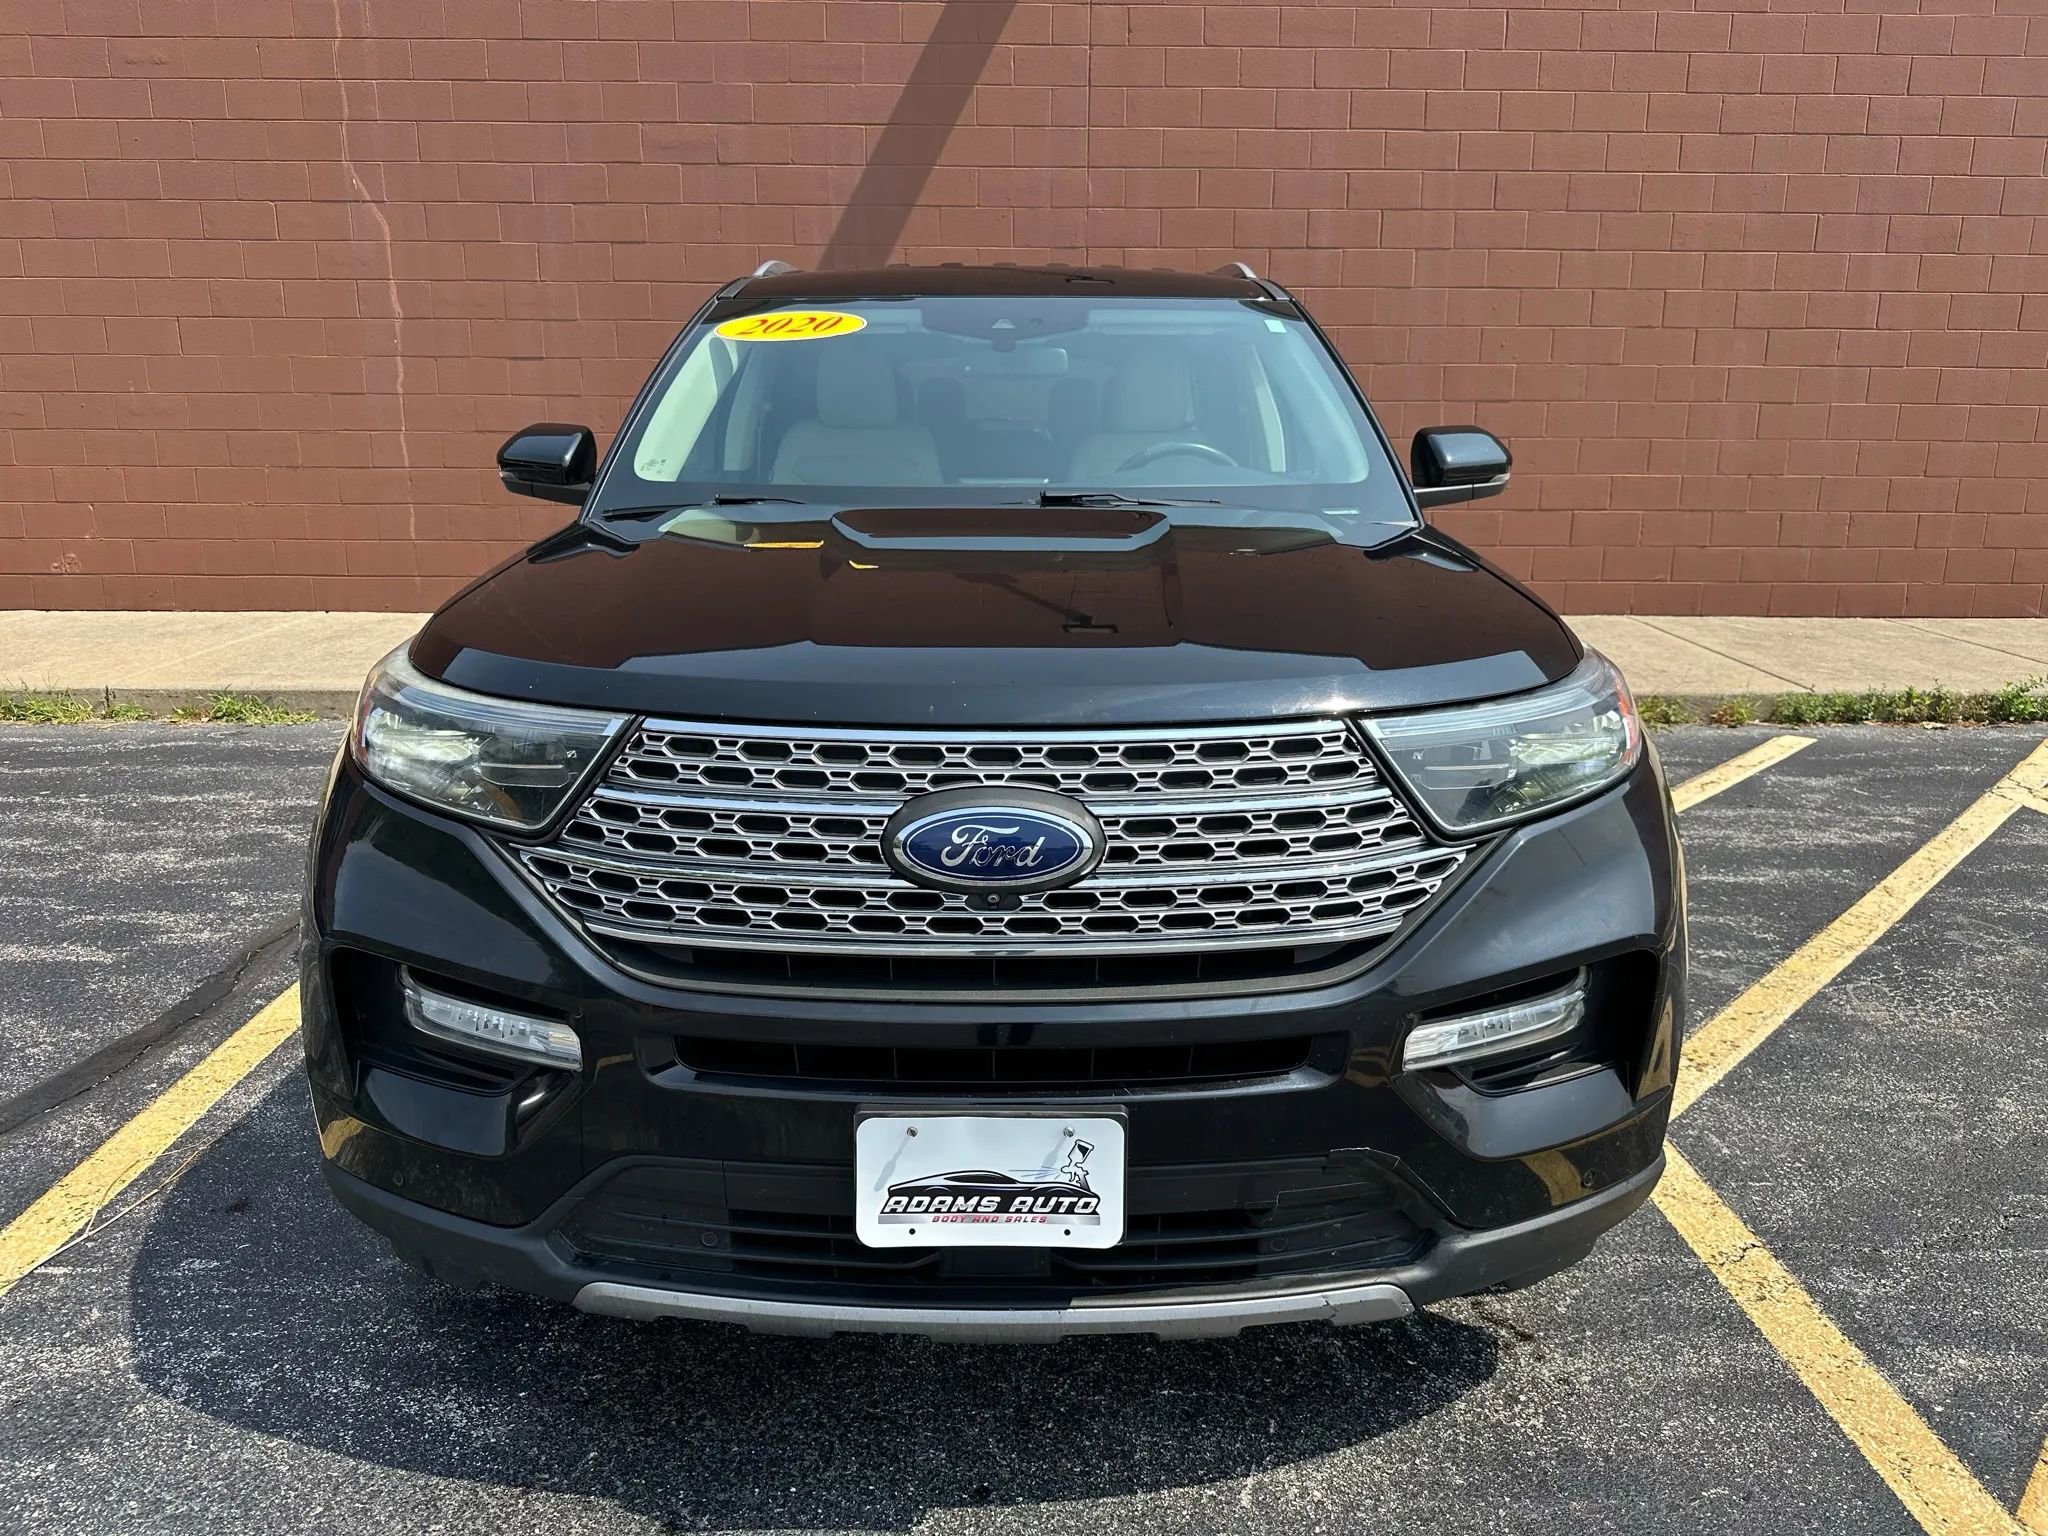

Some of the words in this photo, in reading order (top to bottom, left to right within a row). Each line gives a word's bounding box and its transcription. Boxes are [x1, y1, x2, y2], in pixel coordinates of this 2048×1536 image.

[735, 316, 843, 335] 2020
[940, 824, 1046, 867] Ford
[883, 1196, 1001, 1213] ADAMS
[1009, 1196, 1099, 1213] AUTO
[932, 1215, 966, 1223] BODY
[972, 1215, 999, 1223] AND
[1005, 1215, 1048, 1223] SALES
